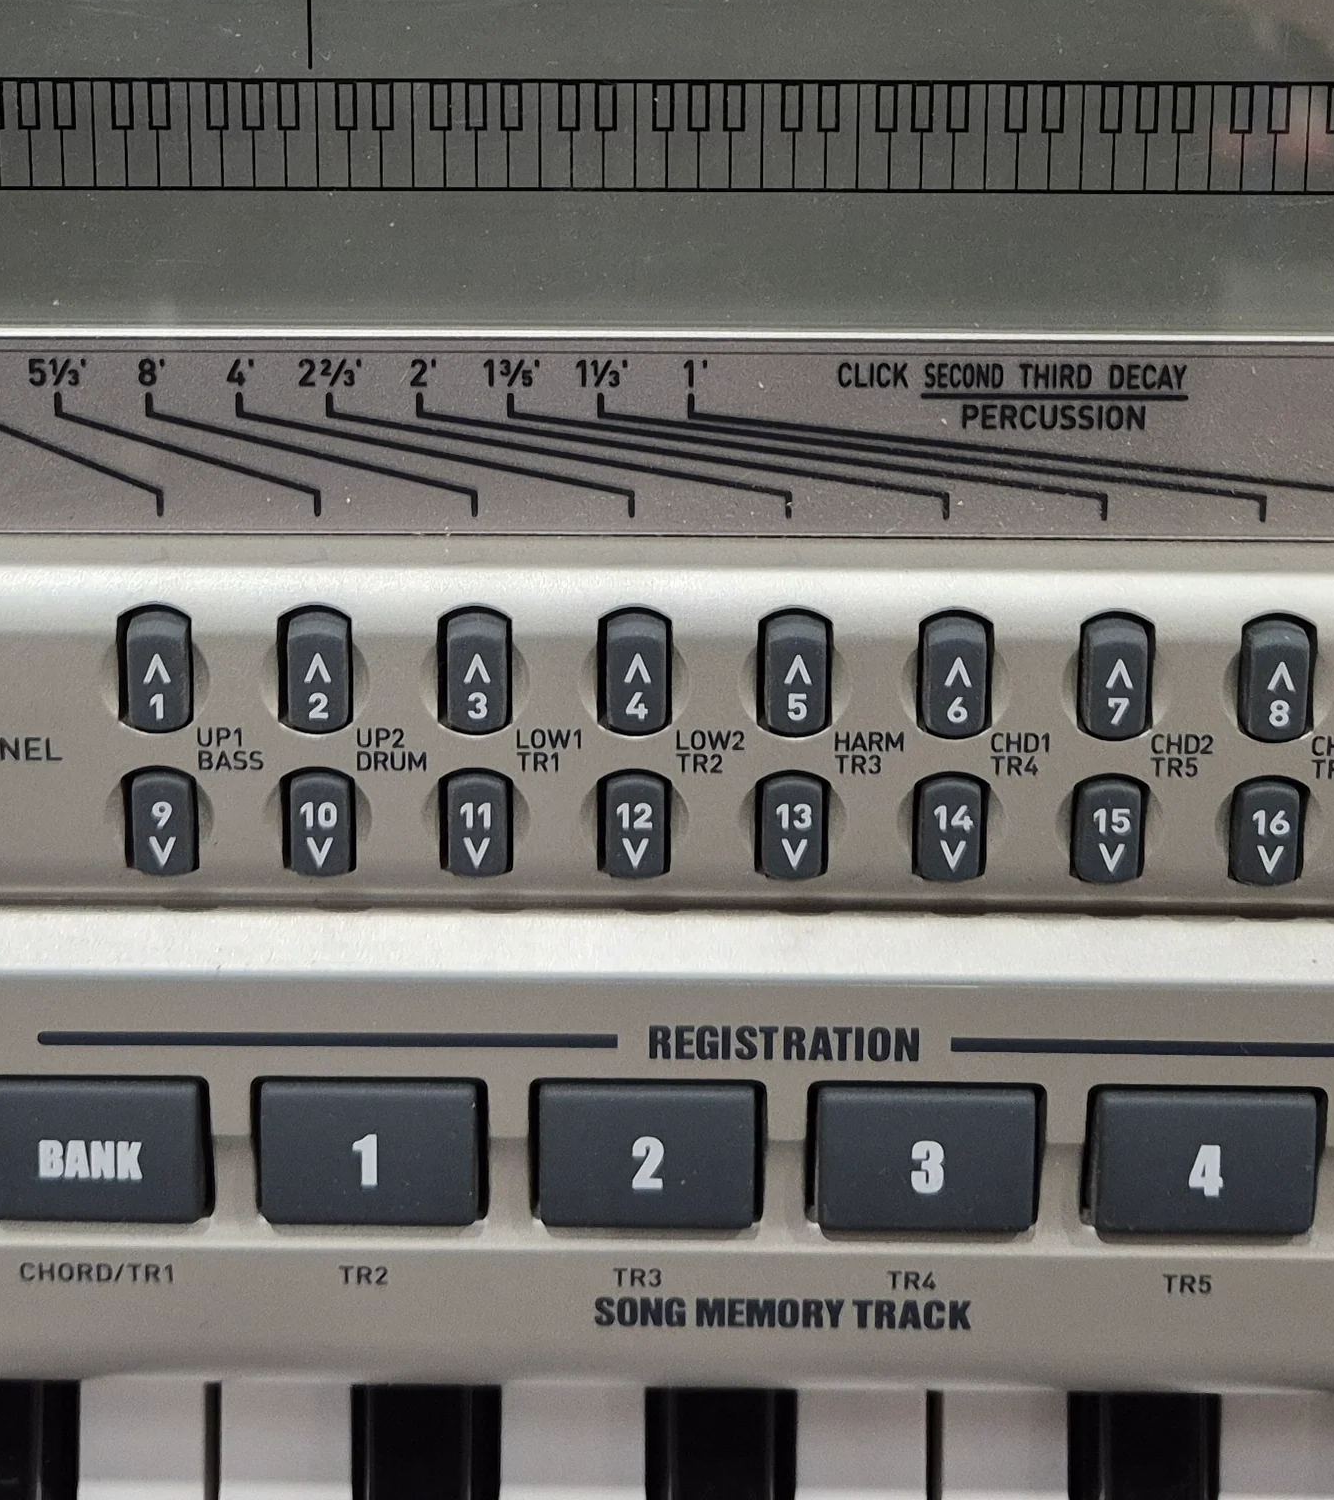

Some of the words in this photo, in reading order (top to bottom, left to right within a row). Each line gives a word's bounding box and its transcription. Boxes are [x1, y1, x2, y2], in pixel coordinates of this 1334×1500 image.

[137, 357, 166, 387] 8'
[226, 358, 255, 387] 4'
[409, 358, 437, 388] 2'
[683, 359, 708, 389] 1'
[837, 361, 909, 389] CLICK
[924, 362, 1004, 390] SECOND
[1018, 362, 1093, 390] THIRD
[1108, 363, 1187, 391] DECAY
[961, 403, 1146, 431] PERCUSSION
[149, 693, 164, 720] 1
[308, 692, 329, 720] 2
[467, 691, 488, 720] 3
[625, 691, 649, 720] 4
[787, 693, 807, 721] 5
[947, 696, 968, 724] 6
[1107, 697, 1130, 725] 7
[1268, 699, 1290, 728] 8
[196, 727, 243, 748] UP1
[356, 727, 405, 749] UP2
[516, 728, 582, 750] LOW1
[675, 729, 745, 751] LOW2
[834, 731, 905, 752] HARM
[990, 732, 1050, 754] CHD1
[1150, 733, 1214, 755] CHD2
[197, 750, 264, 771] BASS
[356, 750, 427, 772] DRUM
[517, 751, 559, 772] TR1
[676, 753, 724, 775] TR2
[835, 754, 882, 775] TR3
[991, 755, 1039, 777] TR4
[1151, 756, 1198, 778] TR5
[151, 801, 173, 828] 9
[300, 801, 338, 829] 10
[460, 802, 491, 829] 11
[616, 802, 653, 829] 12
[776, 803, 812, 830] 13
[934, 805, 974, 832] 14
[1093, 808, 1131, 834] 15
[1252, 809, 1291, 836] 16
[648, 1025, 920, 1063] REGISTRATION
[38, 1139, 143, 1181] BANK
[352, 1133, 378, 1187] 1
[631, 1136, 665, 1190] 2
[910, 1140, 945, 1194] 3
[1188, 1144, 1224, 1197] 4
[19, 1262, 174, 1283] CHORD/TR1
[340, 1266, 388, 1286] TR2
[614, 1268, 662, 1288] TR3
[889, 1271, 936, 1291] TR4
[1164, 1274, 1212, 1295] TR5
[594, 1297, 686, 1328] SONG
[695, 1298, 845, 1329] MEMORY
[852, 1299, 971, 1331] TRACK
